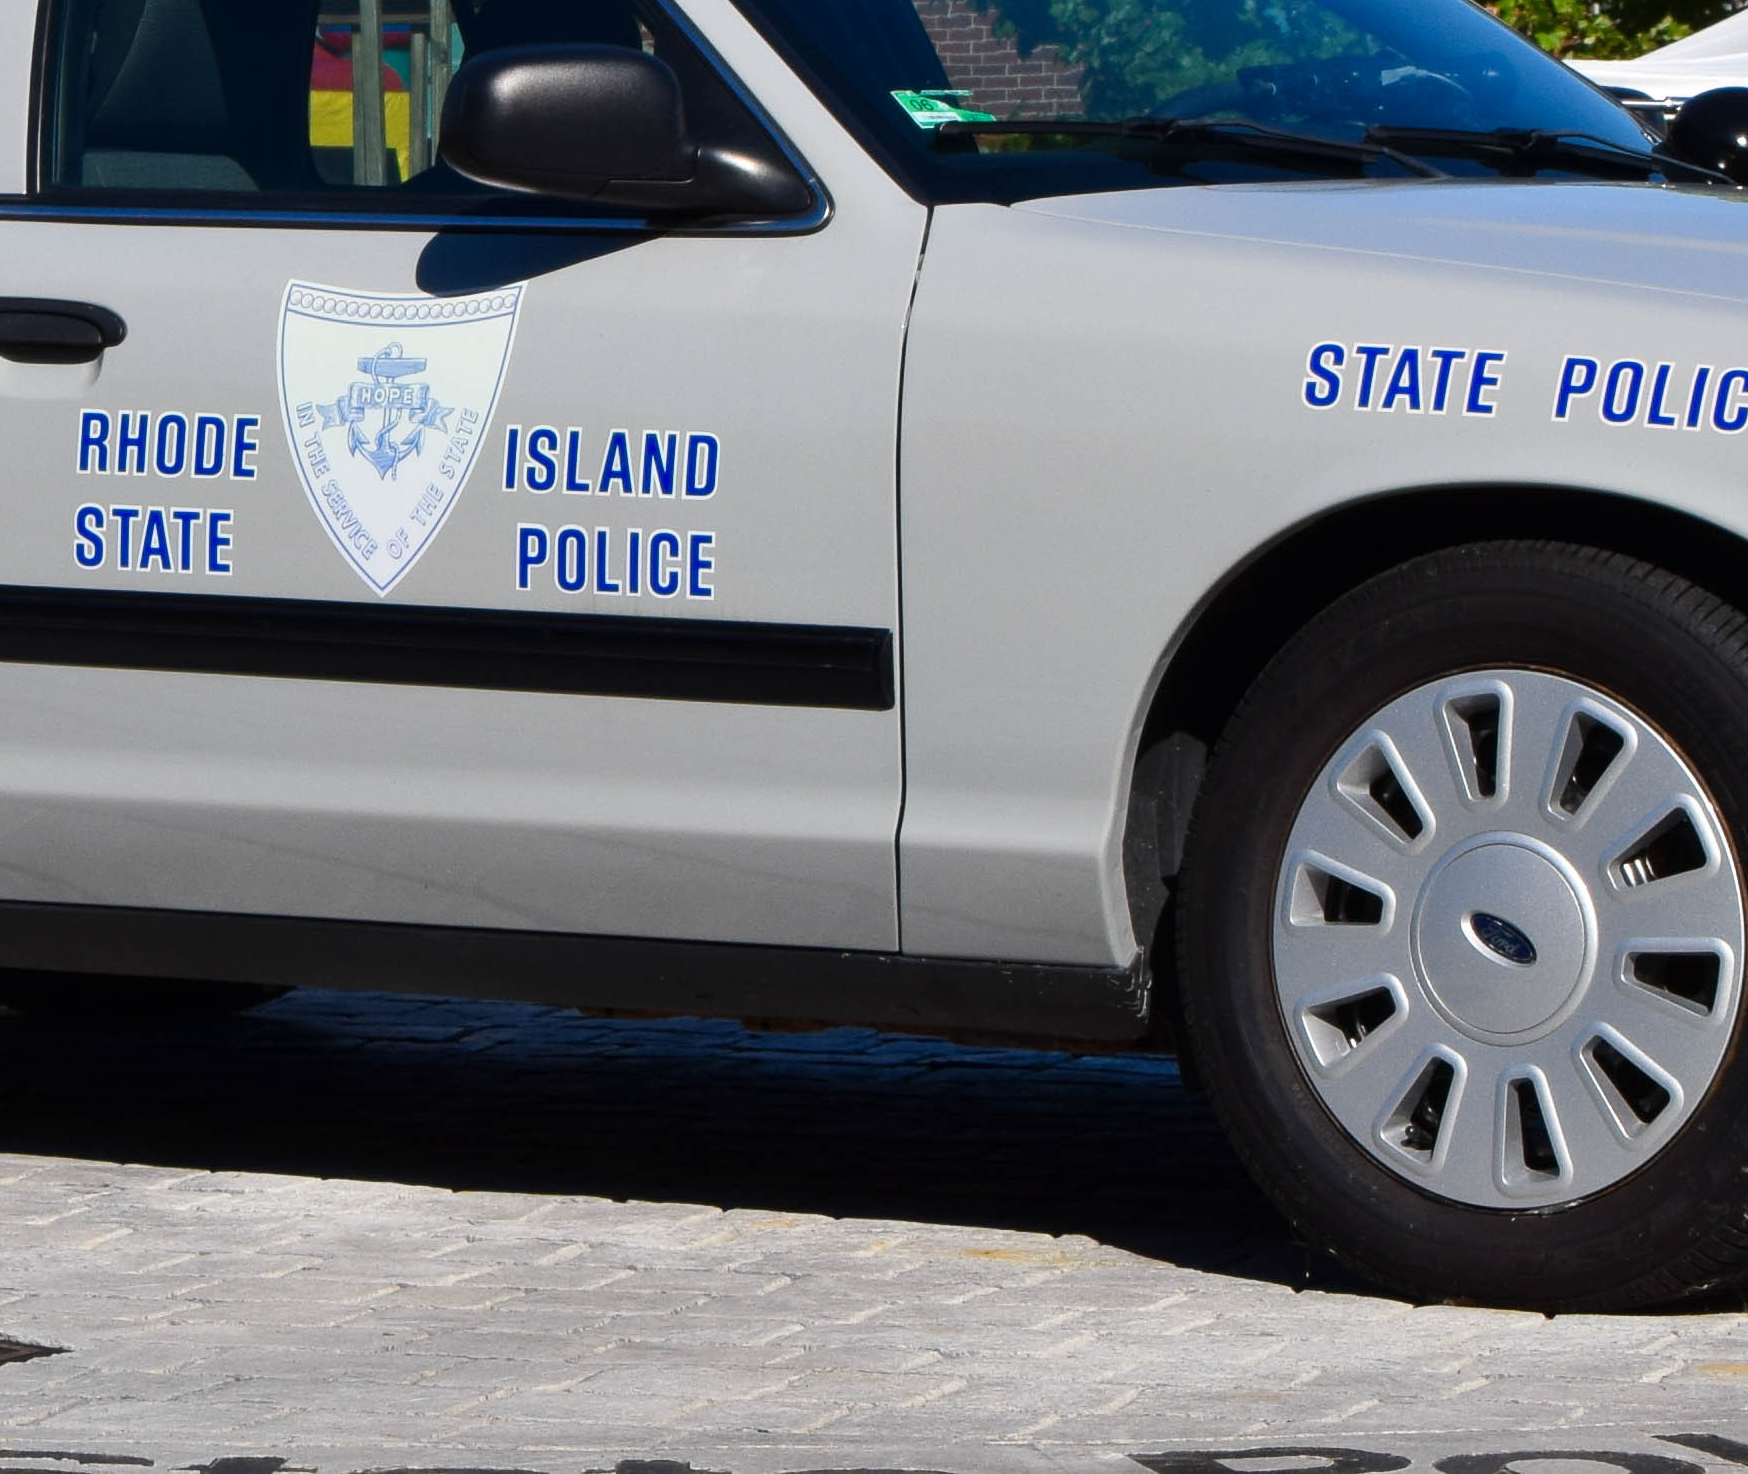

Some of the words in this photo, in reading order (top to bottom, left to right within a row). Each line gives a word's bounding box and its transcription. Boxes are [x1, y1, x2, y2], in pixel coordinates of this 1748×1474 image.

[361, 386, 415, 406] HOPE
[1302, 341, 1508, 418] STATE
[295, 401, 316, 428] IN
[439, 406, 479, 480] STATE
[77, 408, 261, 480] RHODE
[502, 424, 720, 500] ISLAND
[304, 431, 331, 479] THE
[321, 478, 378, 561] SERVICE
[410, 483, 445, 527] THE
[74, 502, 234, 576] STATE
[516, 523, 716, 600] POLICE
[386, 528, 411, 560] OF
